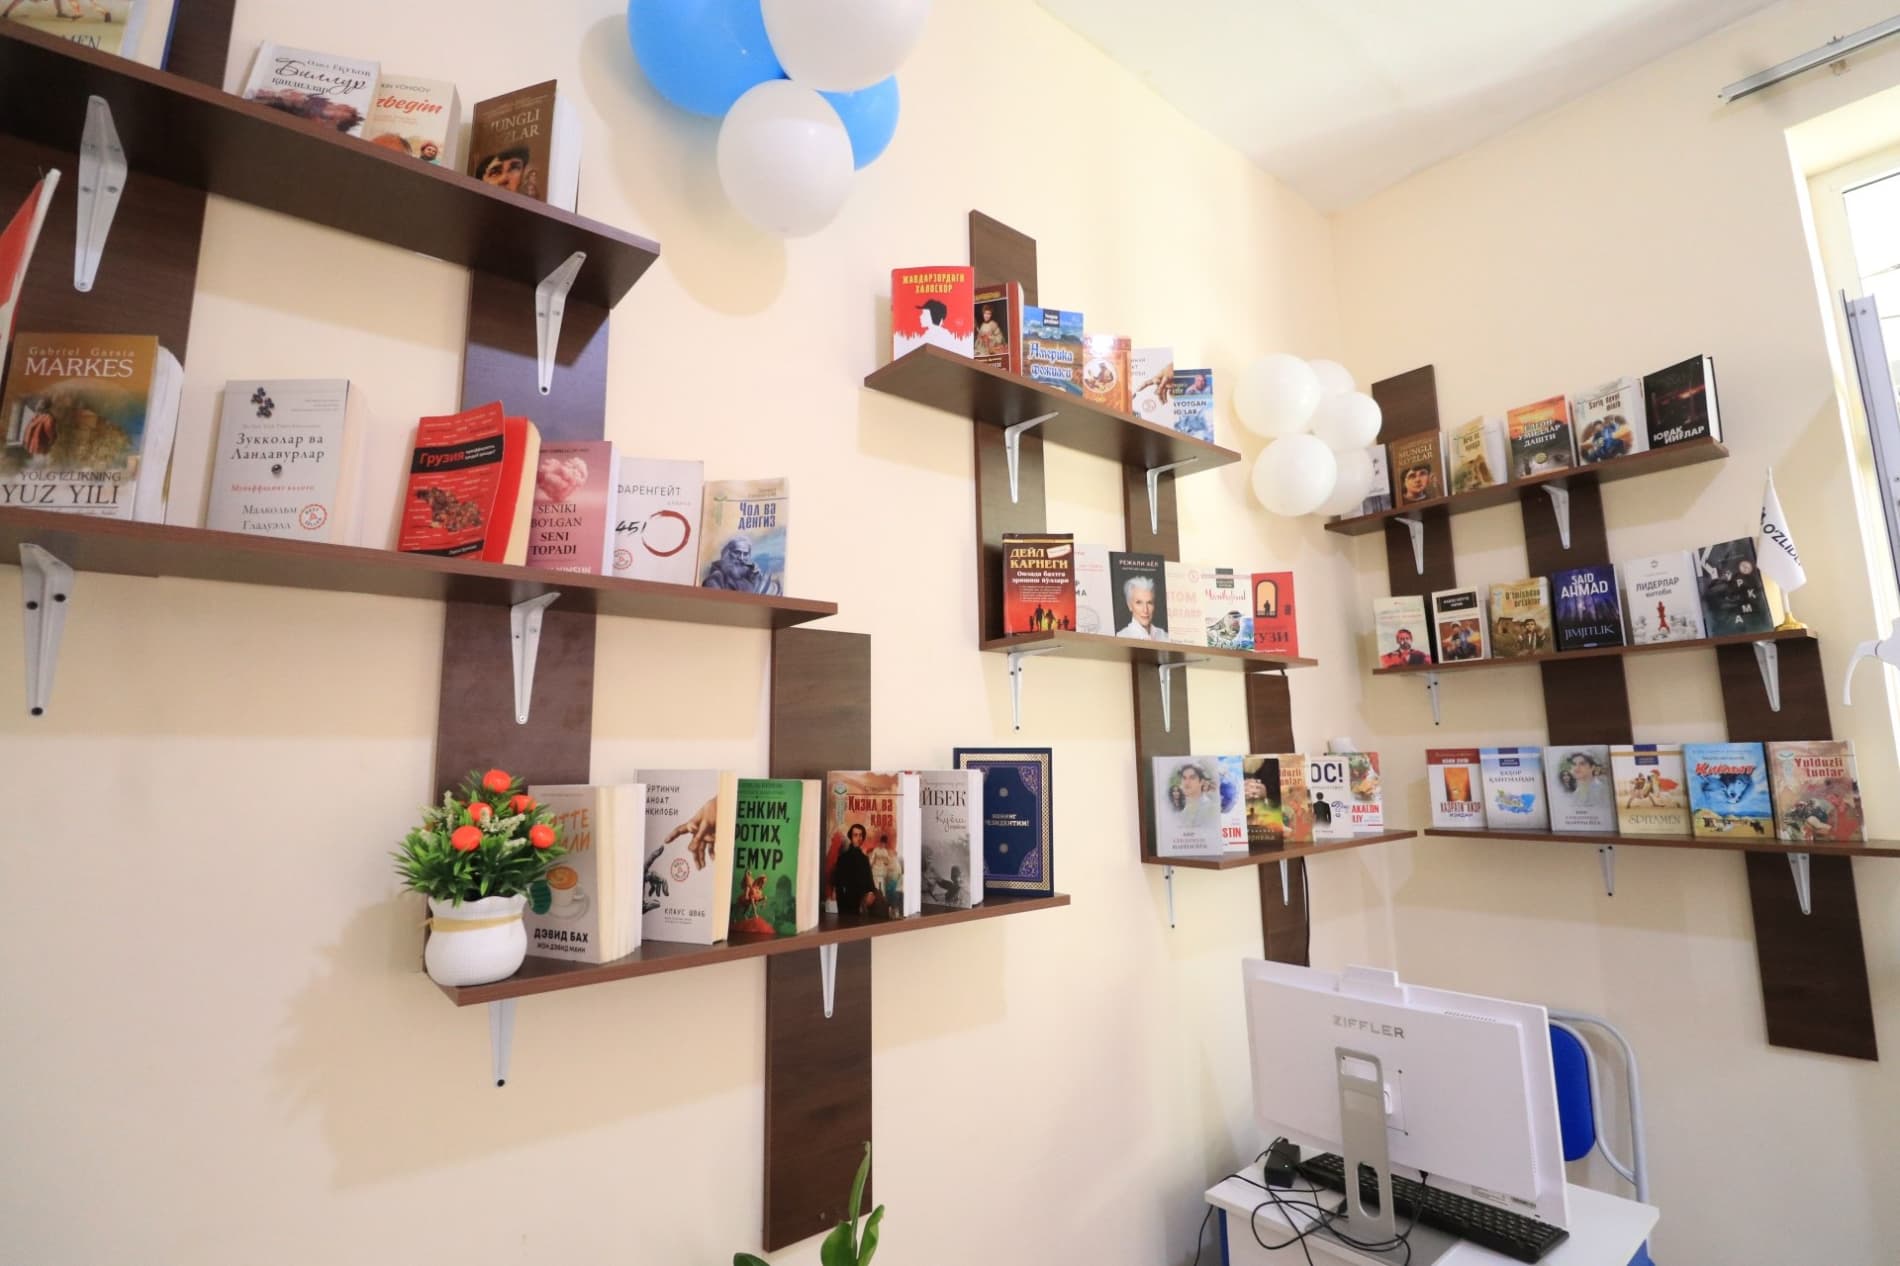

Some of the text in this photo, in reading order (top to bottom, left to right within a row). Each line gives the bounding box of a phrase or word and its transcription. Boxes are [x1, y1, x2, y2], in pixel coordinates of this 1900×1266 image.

[29, 347, 80, 356] Gabriel
[24, 357, 133, 378] MARKES
[235, 432, 324, 448] Зукколар ва
[230, 448, 325, 463] Ландавурлар
[420, 451, 466, 468] Грузия
[2, 484, 119, 504] YUZ YILI
[538, 503, 577, 514] SENIKI
[531, 516, 582, 529] BO'LGAN
[615, 520, 648, 536] 451
[540, 531, 569, 542] SENI
[529, 544, 577, 556] TOPADI
[1010, 546, 1045, 559] ДЕЙЛ
[1010, 559, 1068, 569] КАРНЕГИ
[1570, 572, 1595, 586] SAID
[1635, 576, 1680, 592] ЛИДЕРЛАР
[1560, 579, 1609, 600] AHMAD
[1564, 623, 1615, 641] JIMJITLIK
[1794, 756, 1844, 769] Yulduzli
[1804, 766, 1845, 779] tunlar
[1222, 826, 1242, 838] STIN
[736, 848, 784, 871] ЕМУР
[533, 927, 589, 943] ДЭВИД БАХ
[1331, 1014, 1406, 1040] ZIFFLER
